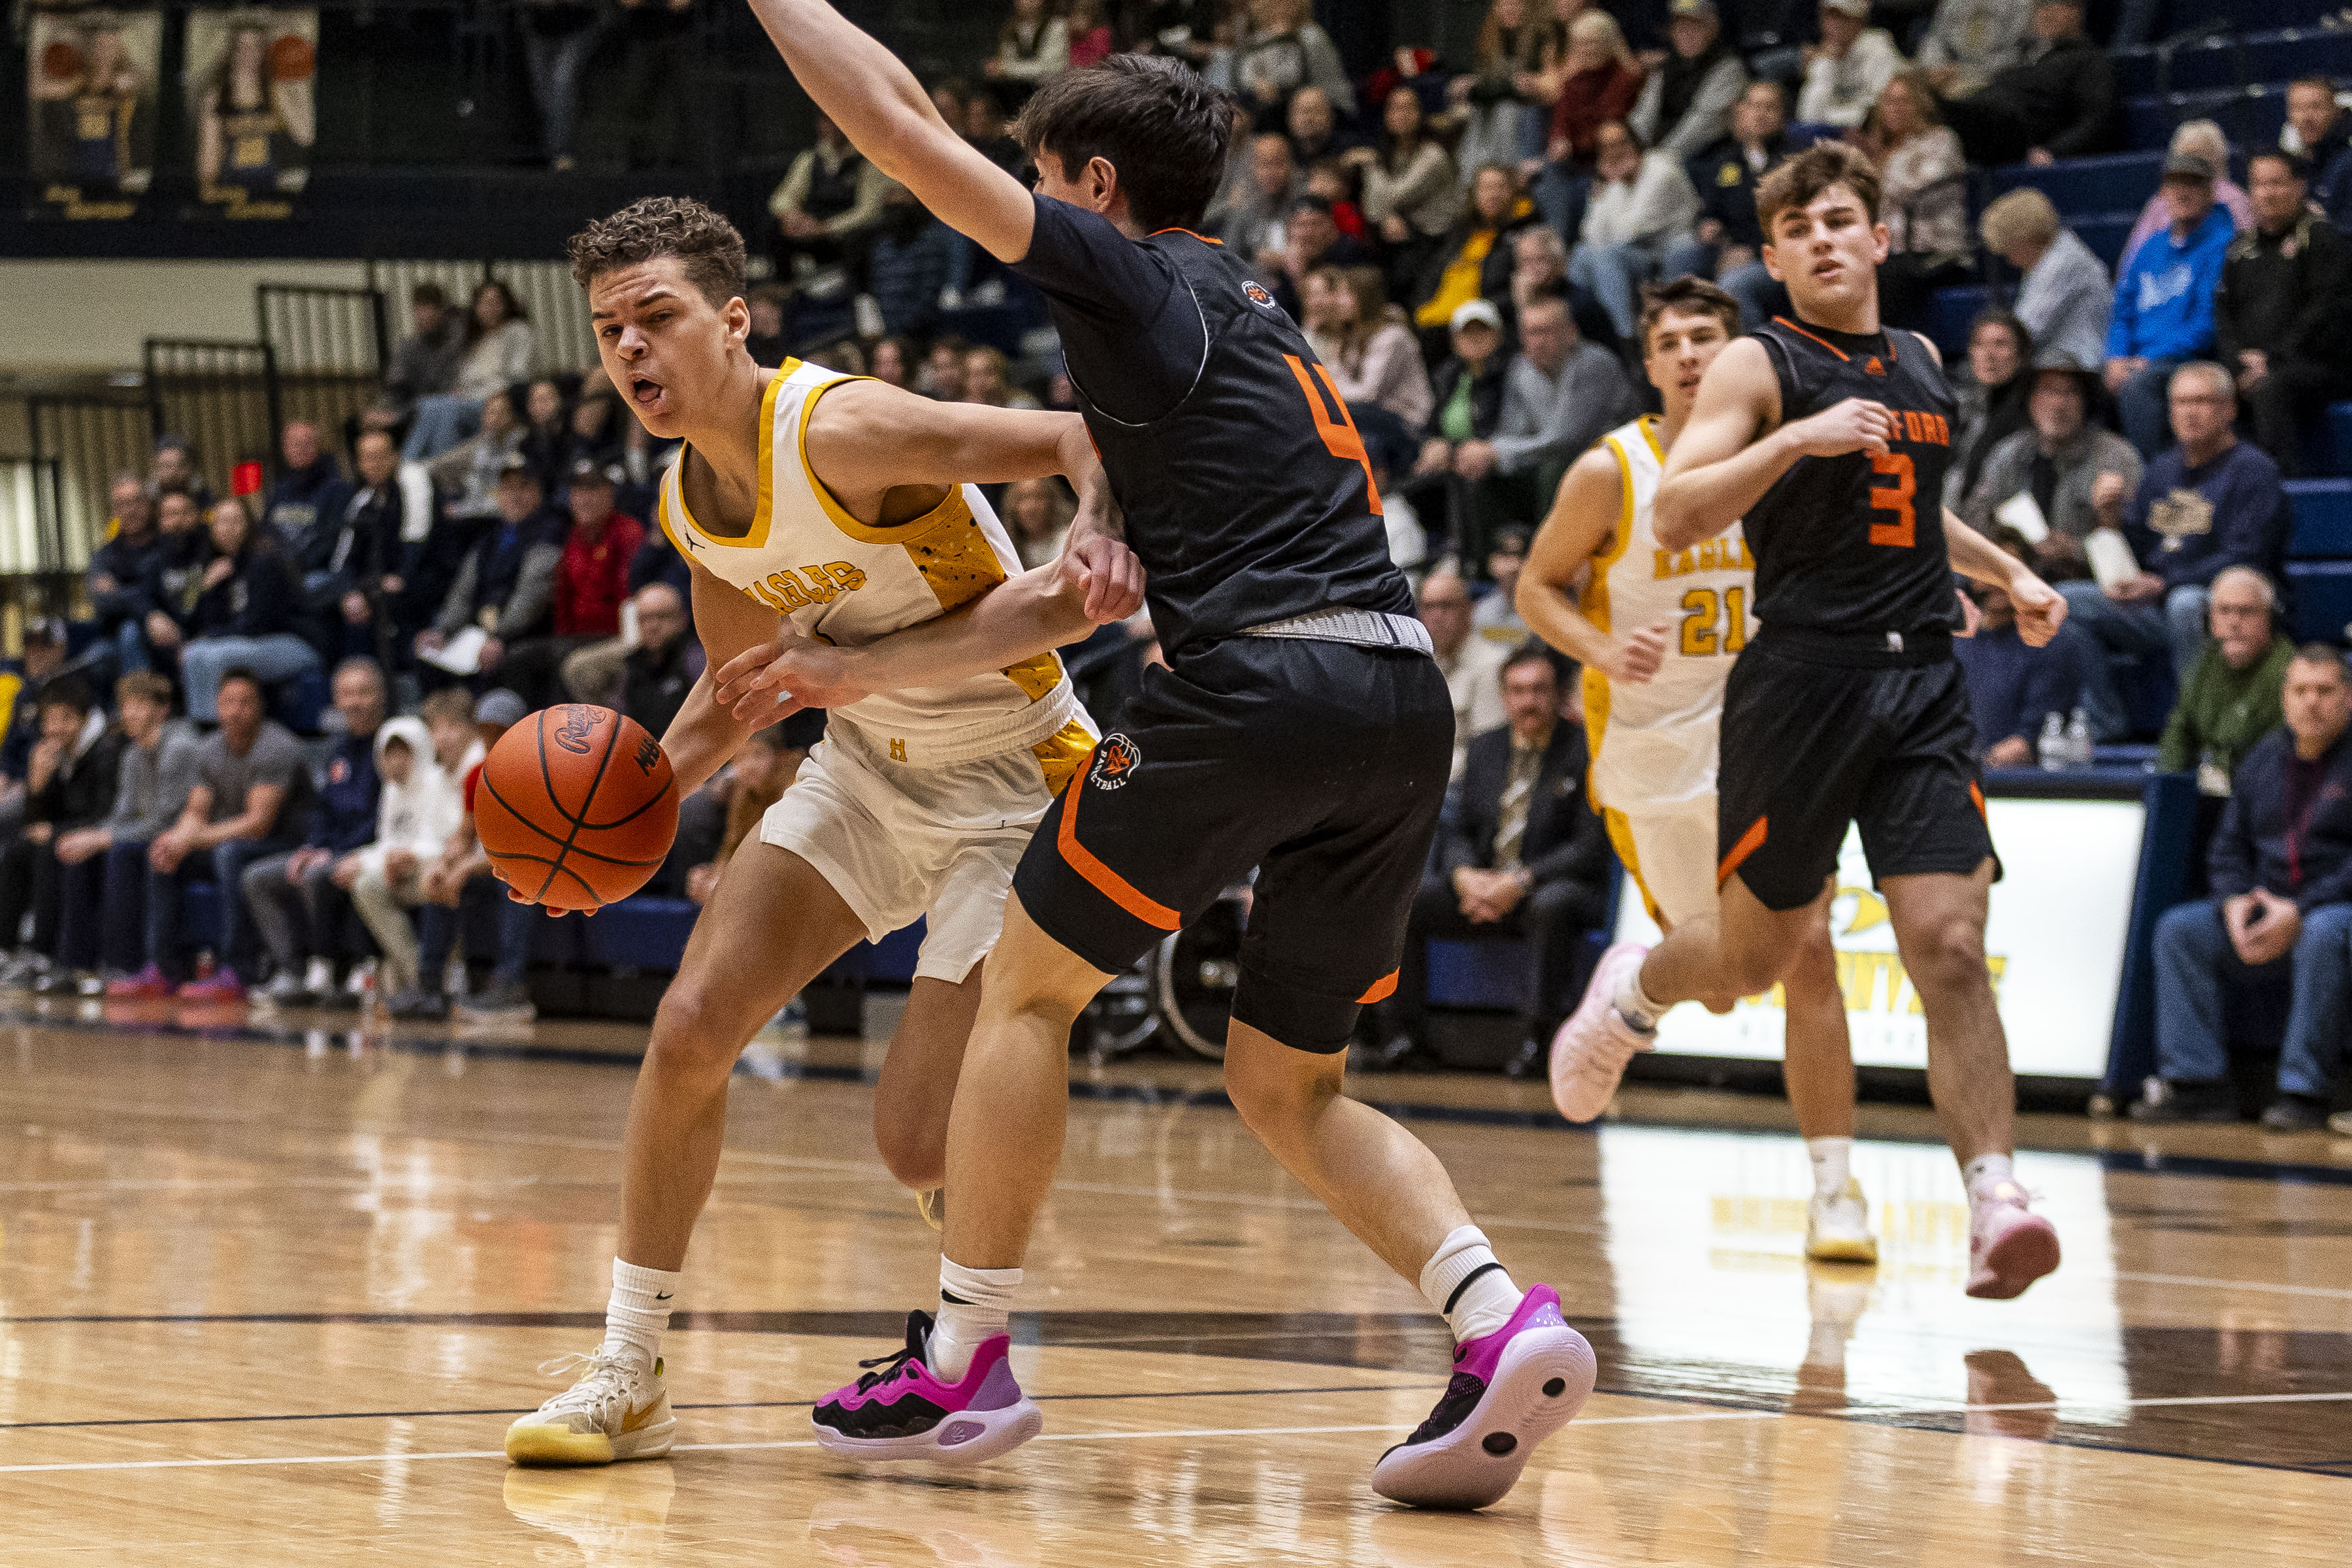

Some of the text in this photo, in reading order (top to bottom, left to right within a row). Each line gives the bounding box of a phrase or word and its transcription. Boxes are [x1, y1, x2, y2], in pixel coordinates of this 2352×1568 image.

[1282, 353, 1384, 515] 4
[1869, 453, 1916, 547] 3
[742, 561, 868, 615] AGLES
[1680, 587, 1746, 655] 21
[890, 738, 907, 762] H
